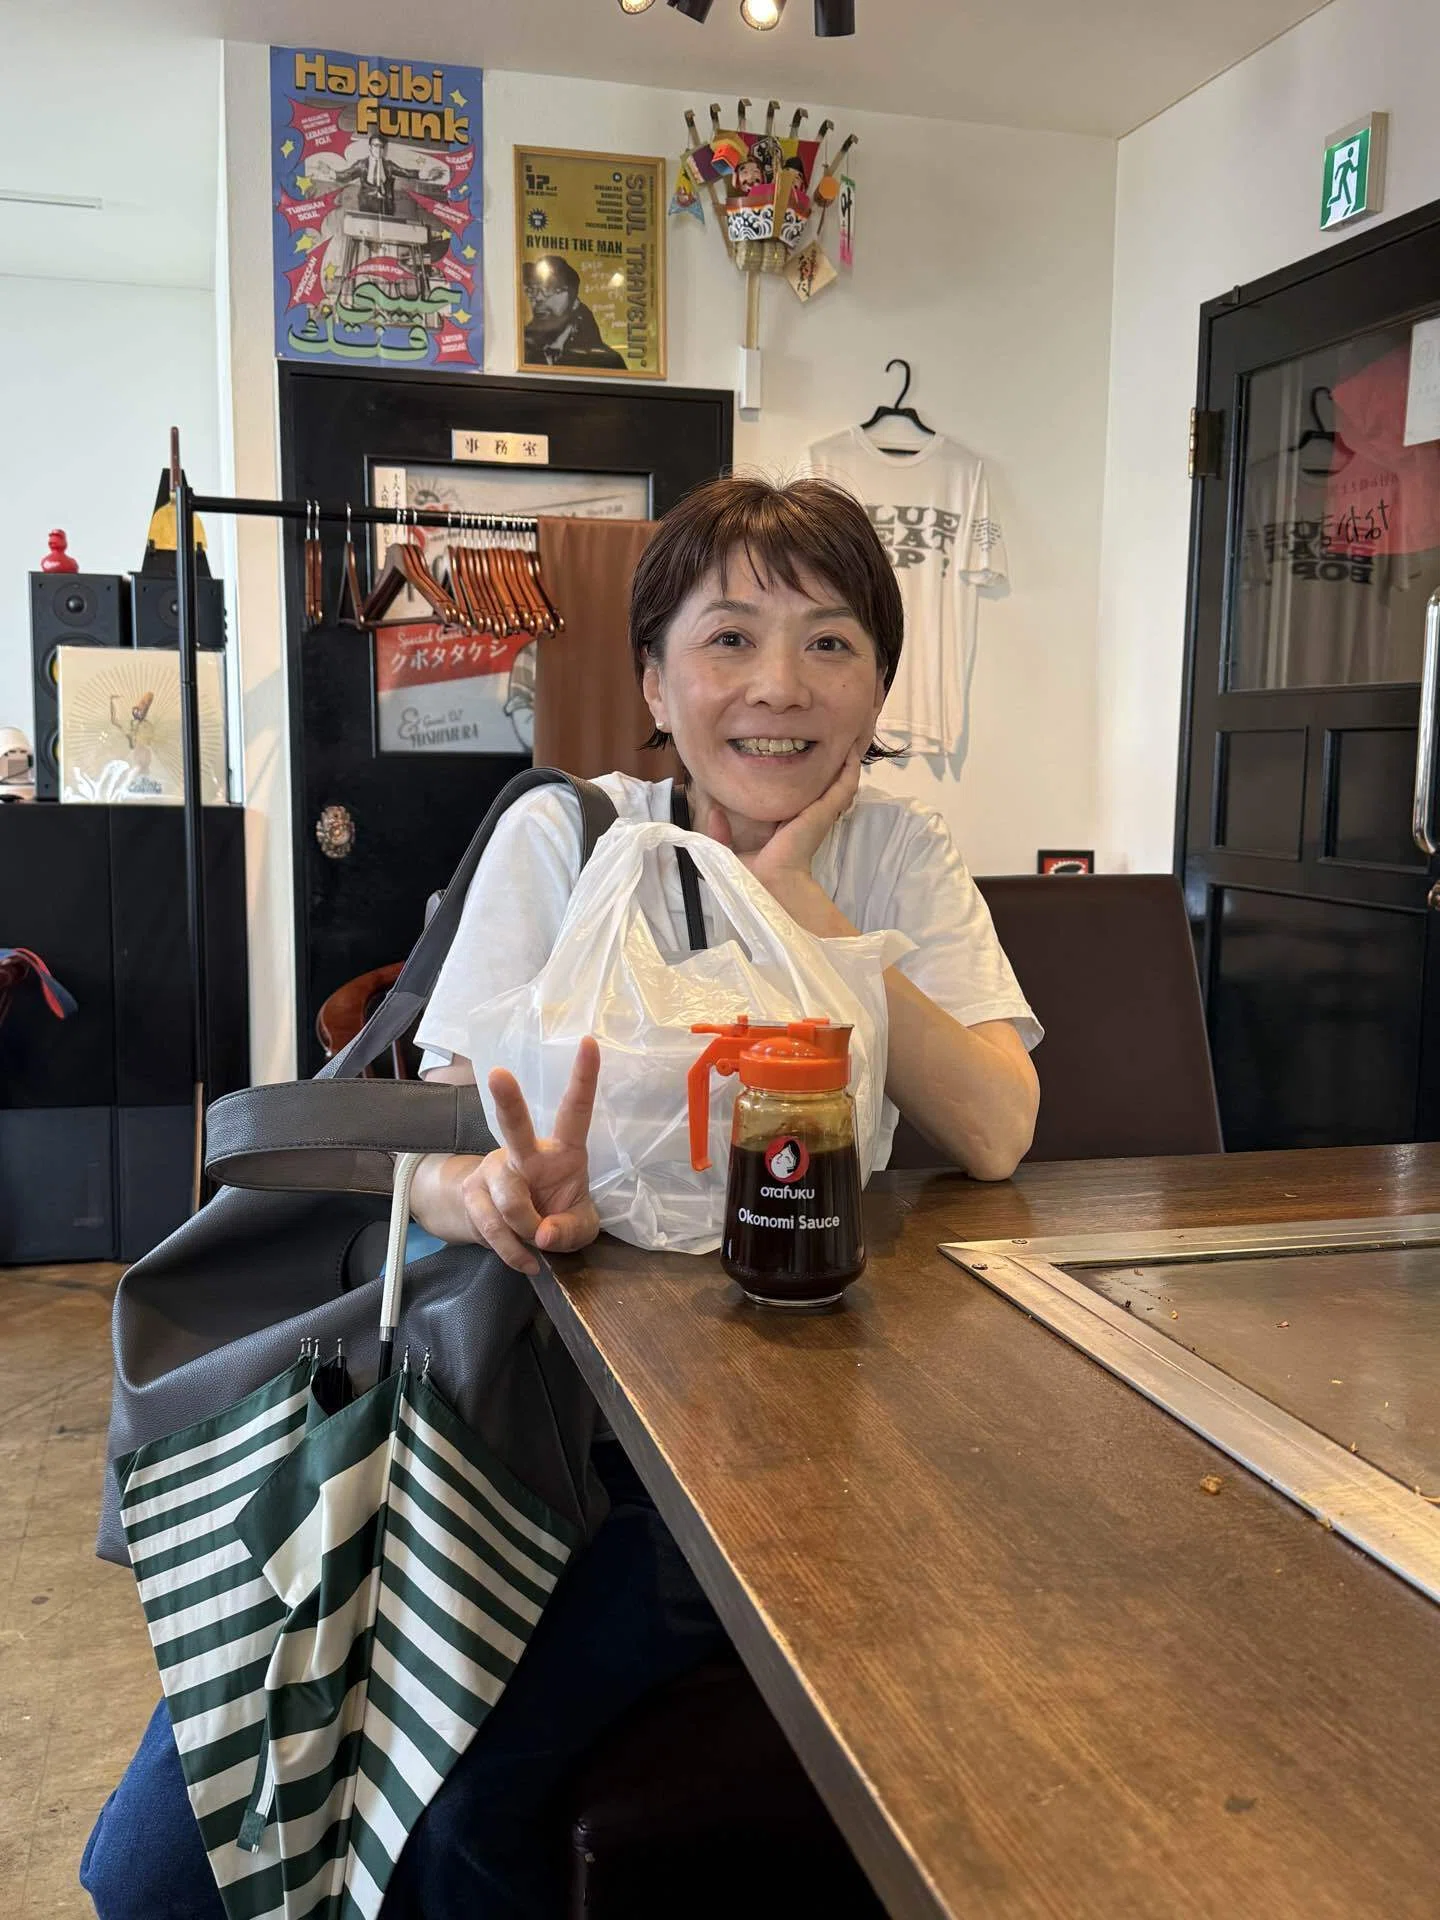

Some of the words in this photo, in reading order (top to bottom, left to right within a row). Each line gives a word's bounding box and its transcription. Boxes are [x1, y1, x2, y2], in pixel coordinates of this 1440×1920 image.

[295, 53, 444, 104] Habibi
[356, 97, 470, 144] Funk
[626, 174, 647, 236] SOUL
[526, 235, 569, 250] RYUHEI
[572, 238, 594, 252] THE
[597, 240, 622, 254] MAN
[864, 504, 961, 534] LUE
[877, 527, 956, 554] EAT
[738, 1207, 795, 1229] Okonomi
[798, 1215, 840, 1230] Sauce
